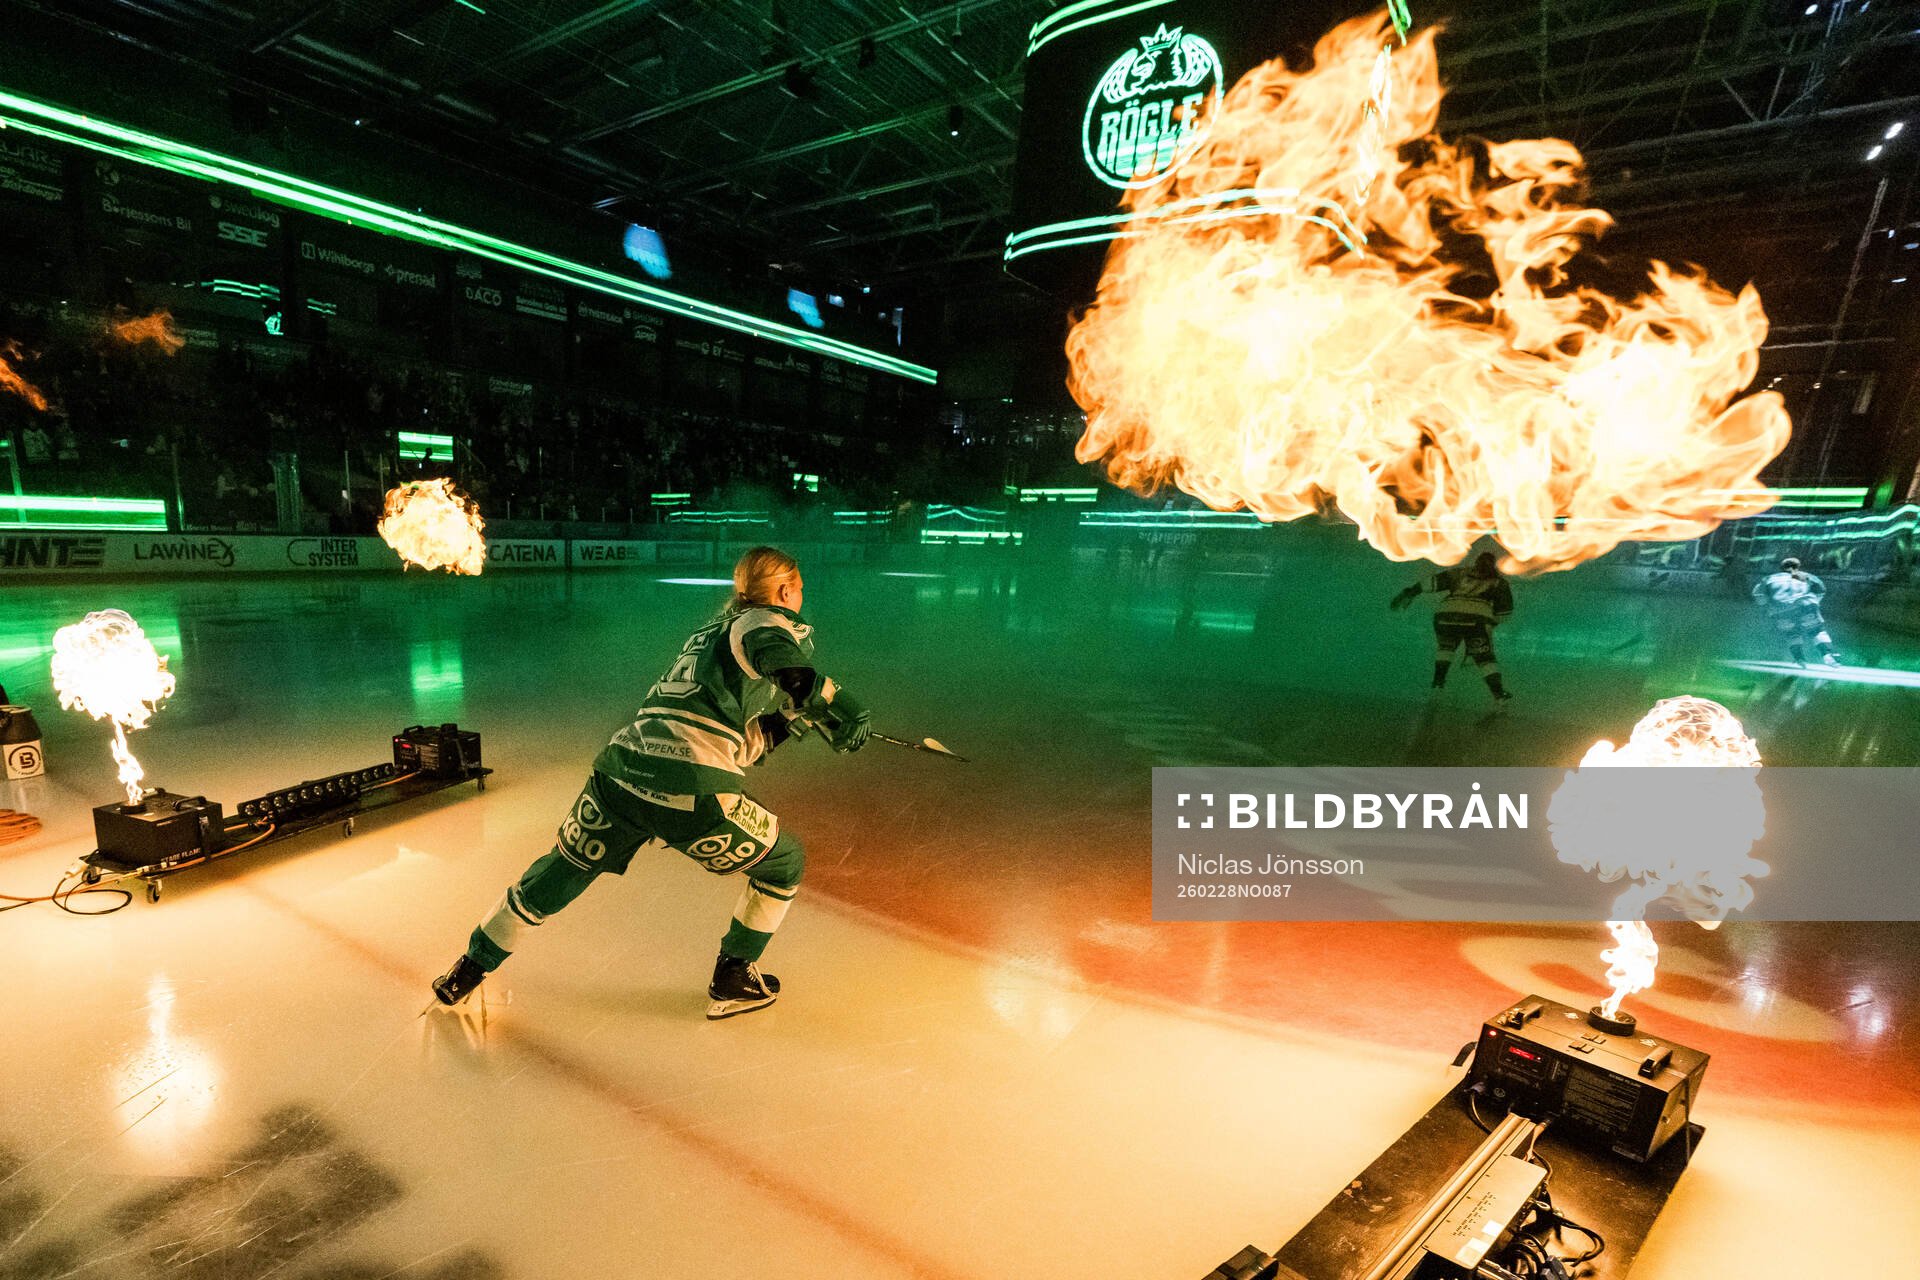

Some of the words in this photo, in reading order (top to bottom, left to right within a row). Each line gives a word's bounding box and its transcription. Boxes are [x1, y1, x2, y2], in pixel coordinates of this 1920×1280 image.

[1097, 92, 1203, 178] RÖGLE
[217, 220, 268, 248] SSE
[320, 538, 357, 552] INTER
[488, 545, 557, 562] CATENA
[308, 552, 359, 567] SYSTEM
